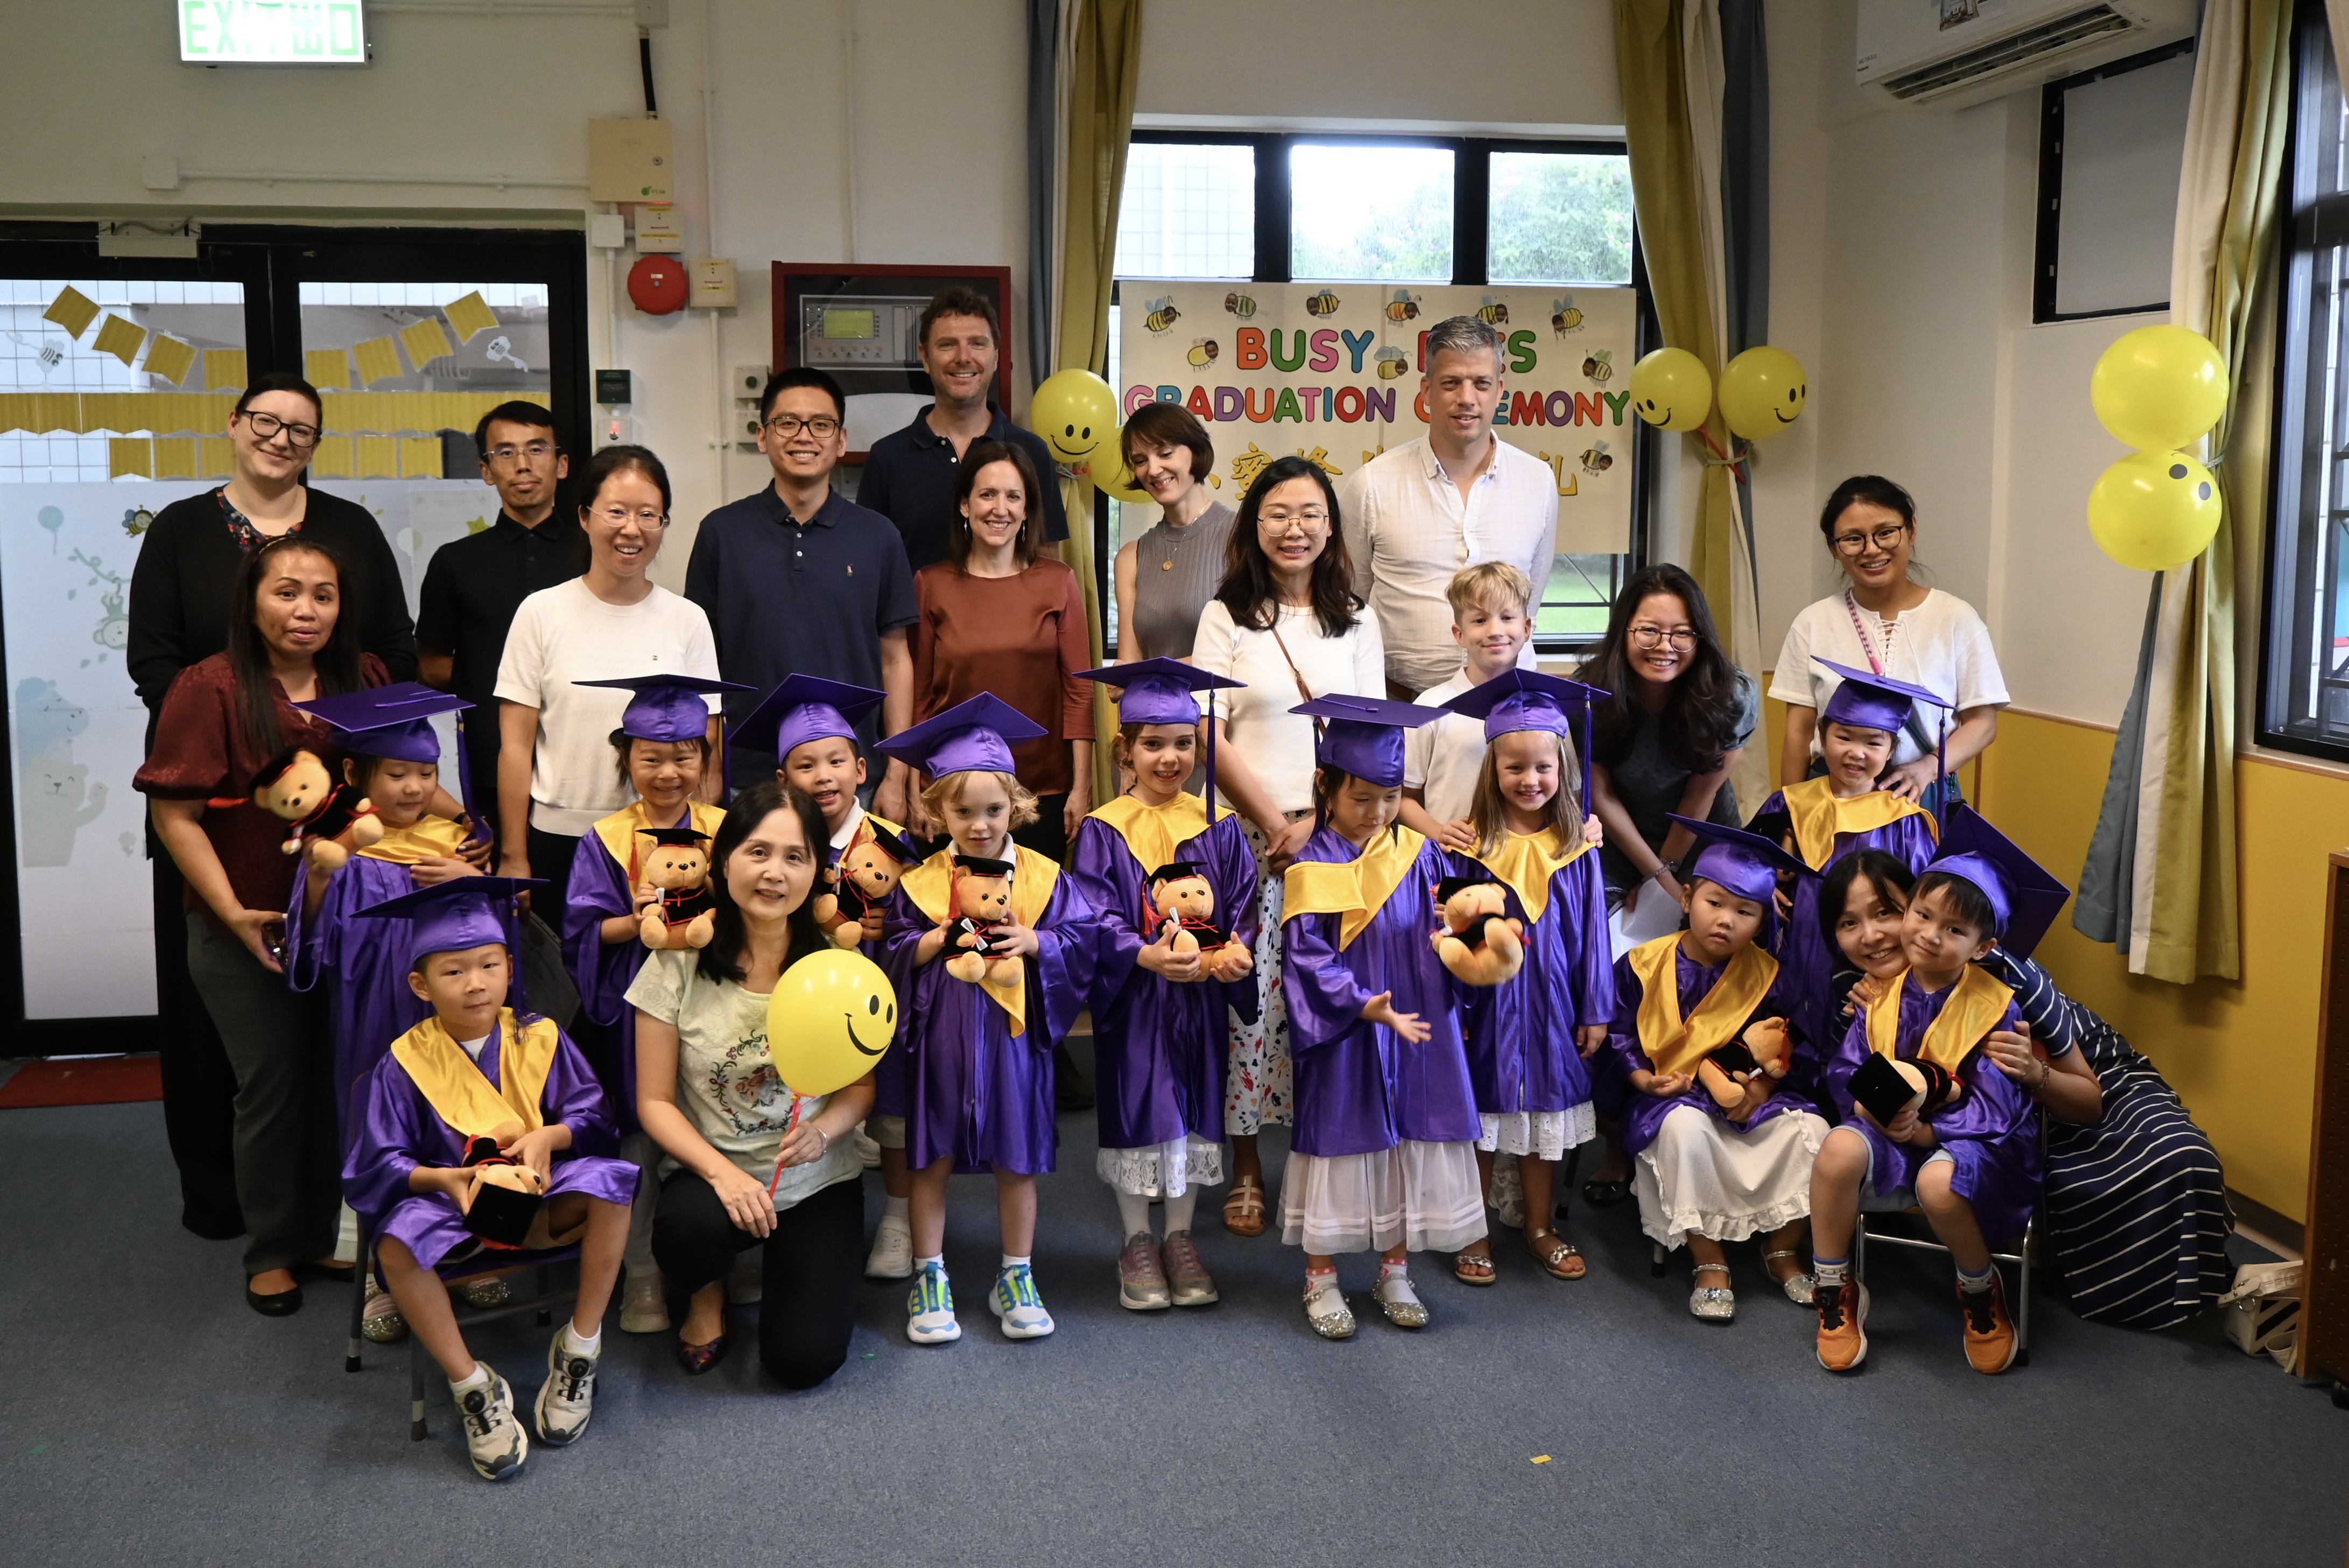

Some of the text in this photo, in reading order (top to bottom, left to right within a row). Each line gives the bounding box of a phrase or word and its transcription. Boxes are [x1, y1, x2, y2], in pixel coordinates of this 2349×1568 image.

[184, 1, 359, 55] EXIT 出口
[1236, 327, 1374, 373] BUSY
[1414, 390, 1630, 427] EMONY
